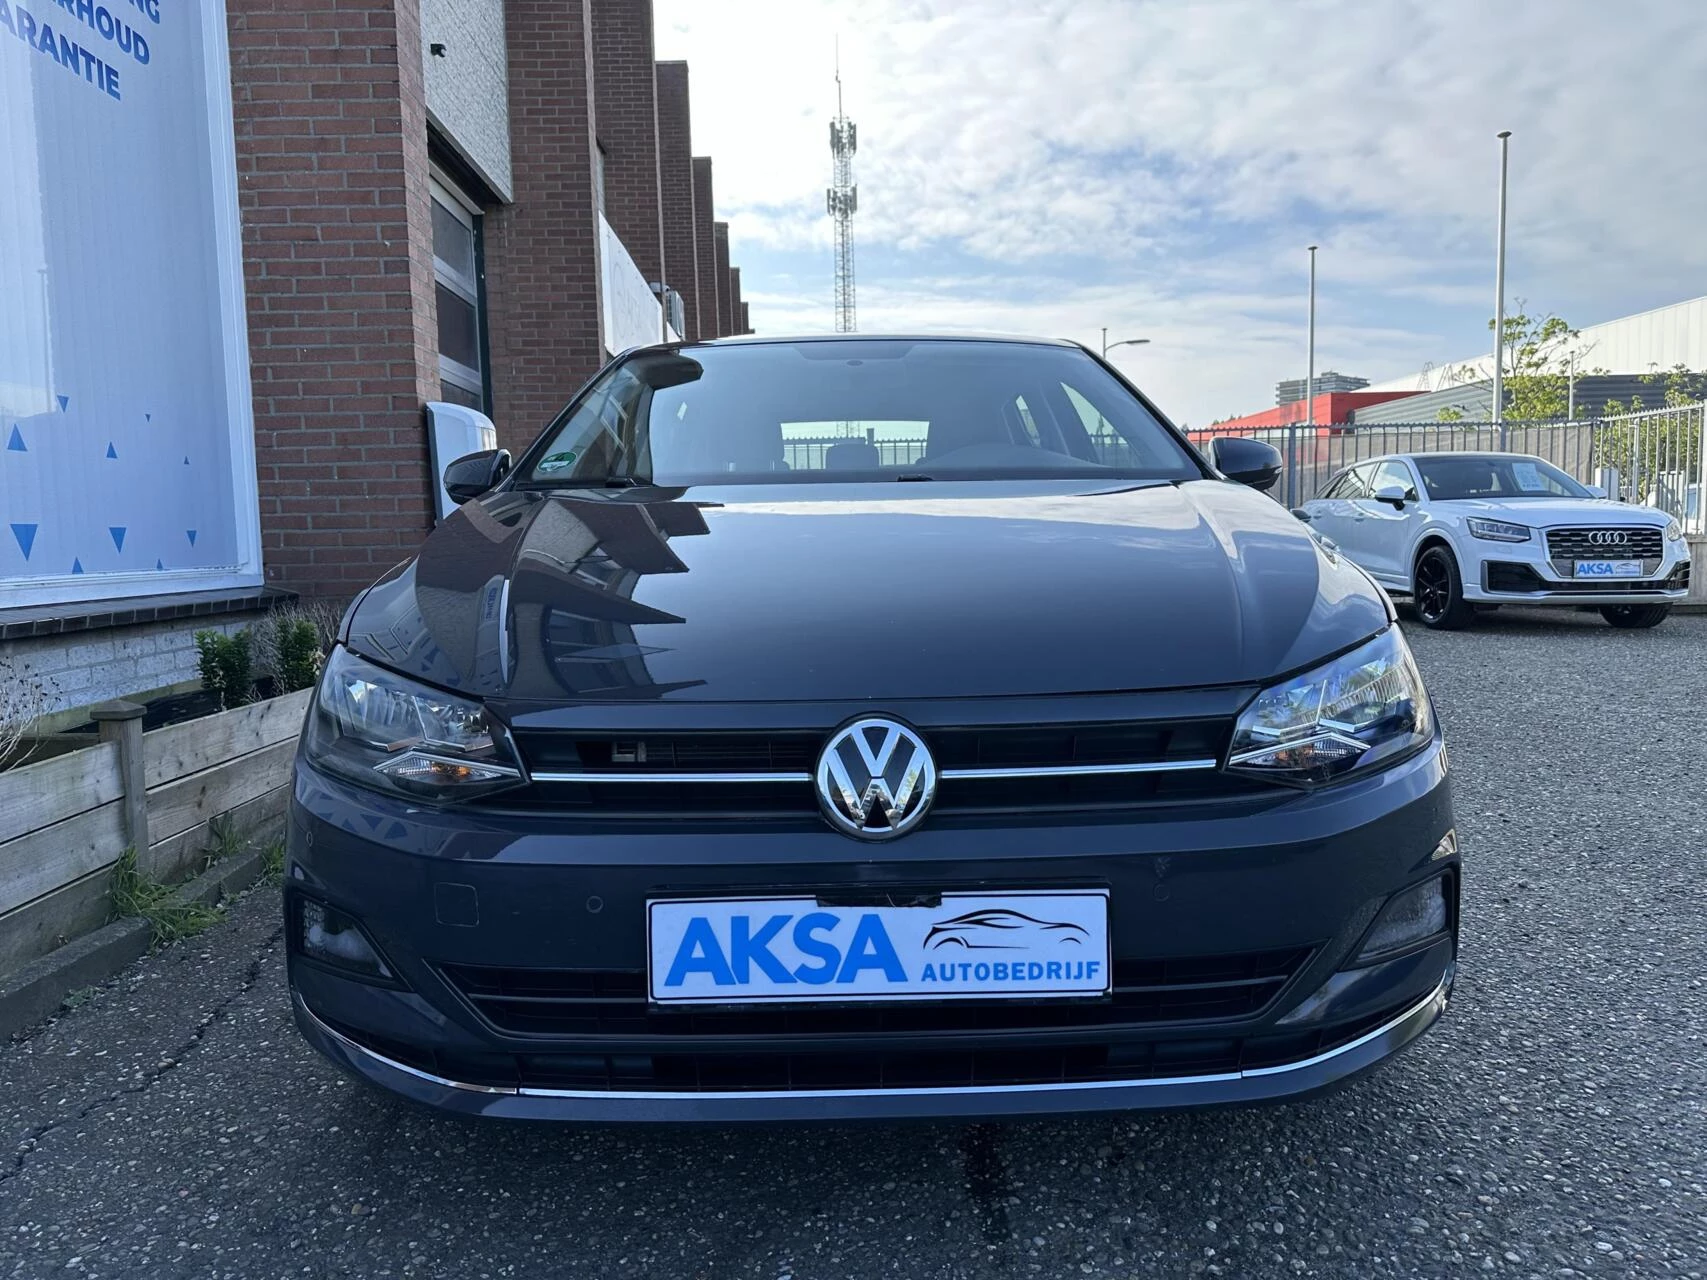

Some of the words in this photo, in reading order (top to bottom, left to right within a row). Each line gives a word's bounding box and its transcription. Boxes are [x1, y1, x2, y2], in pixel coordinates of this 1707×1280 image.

[1578, 563, 1614, 575] AKSA
[664, 912, 908, 987] AKSA
[921, 960, 1100, 983] AUTOBEDRIJF
